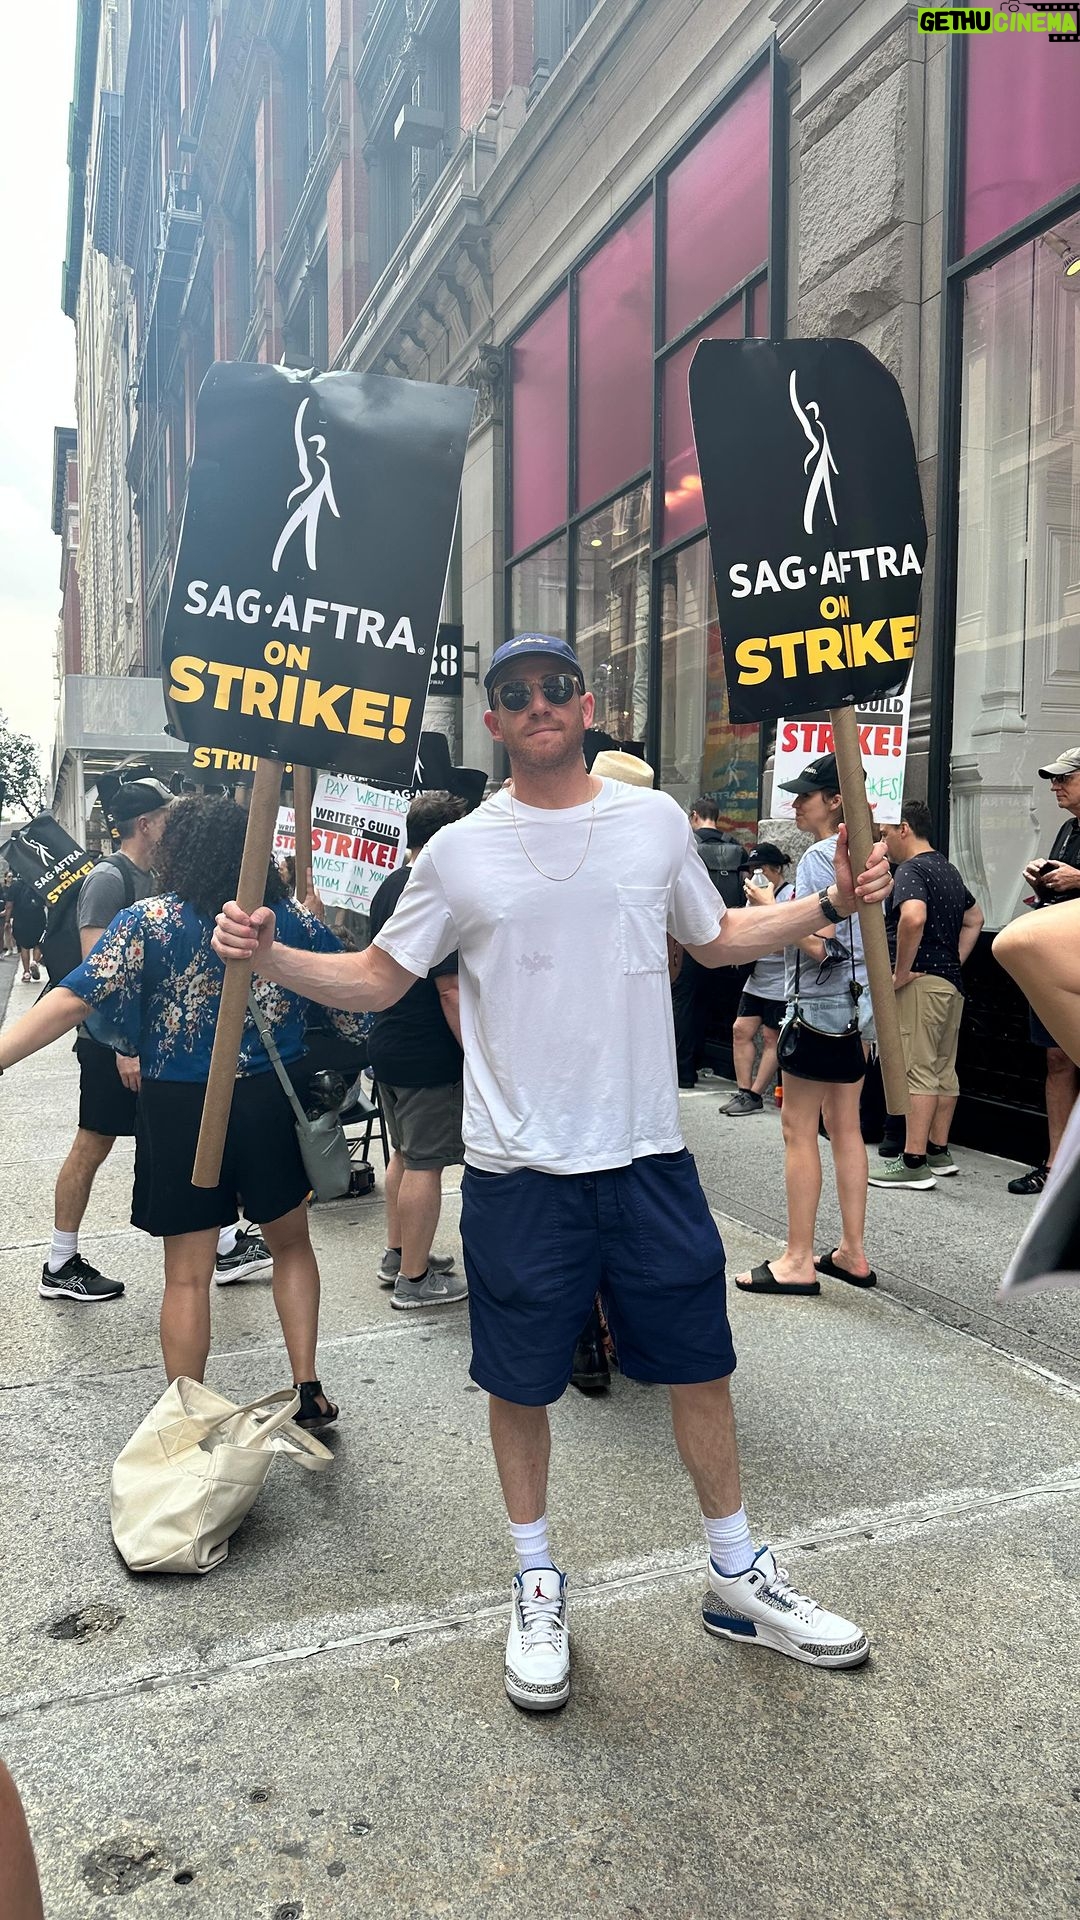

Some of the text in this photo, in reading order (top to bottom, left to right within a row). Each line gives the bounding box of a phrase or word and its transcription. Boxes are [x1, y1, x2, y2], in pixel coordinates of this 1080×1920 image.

[263, 640, 311, 671] ON
[168, 655, 412, 744] STRIKE!
[782, 723, 903, 757] STRKE!
[325, 778, 409, 814] PAY WRITERS
[315, 806, 366, 828] WRITERS
[368, 820, 400, 838] GUILD
[351, 828, 364, 838] ON
[311, 828, 398, 870] STRIKE!
[60, 869, 71, 881] ON
[312, 856, 348, 873] NVEST
[354, 865, 364, 878] IN
[312, 875, 369, 897] OTTOM LINE
